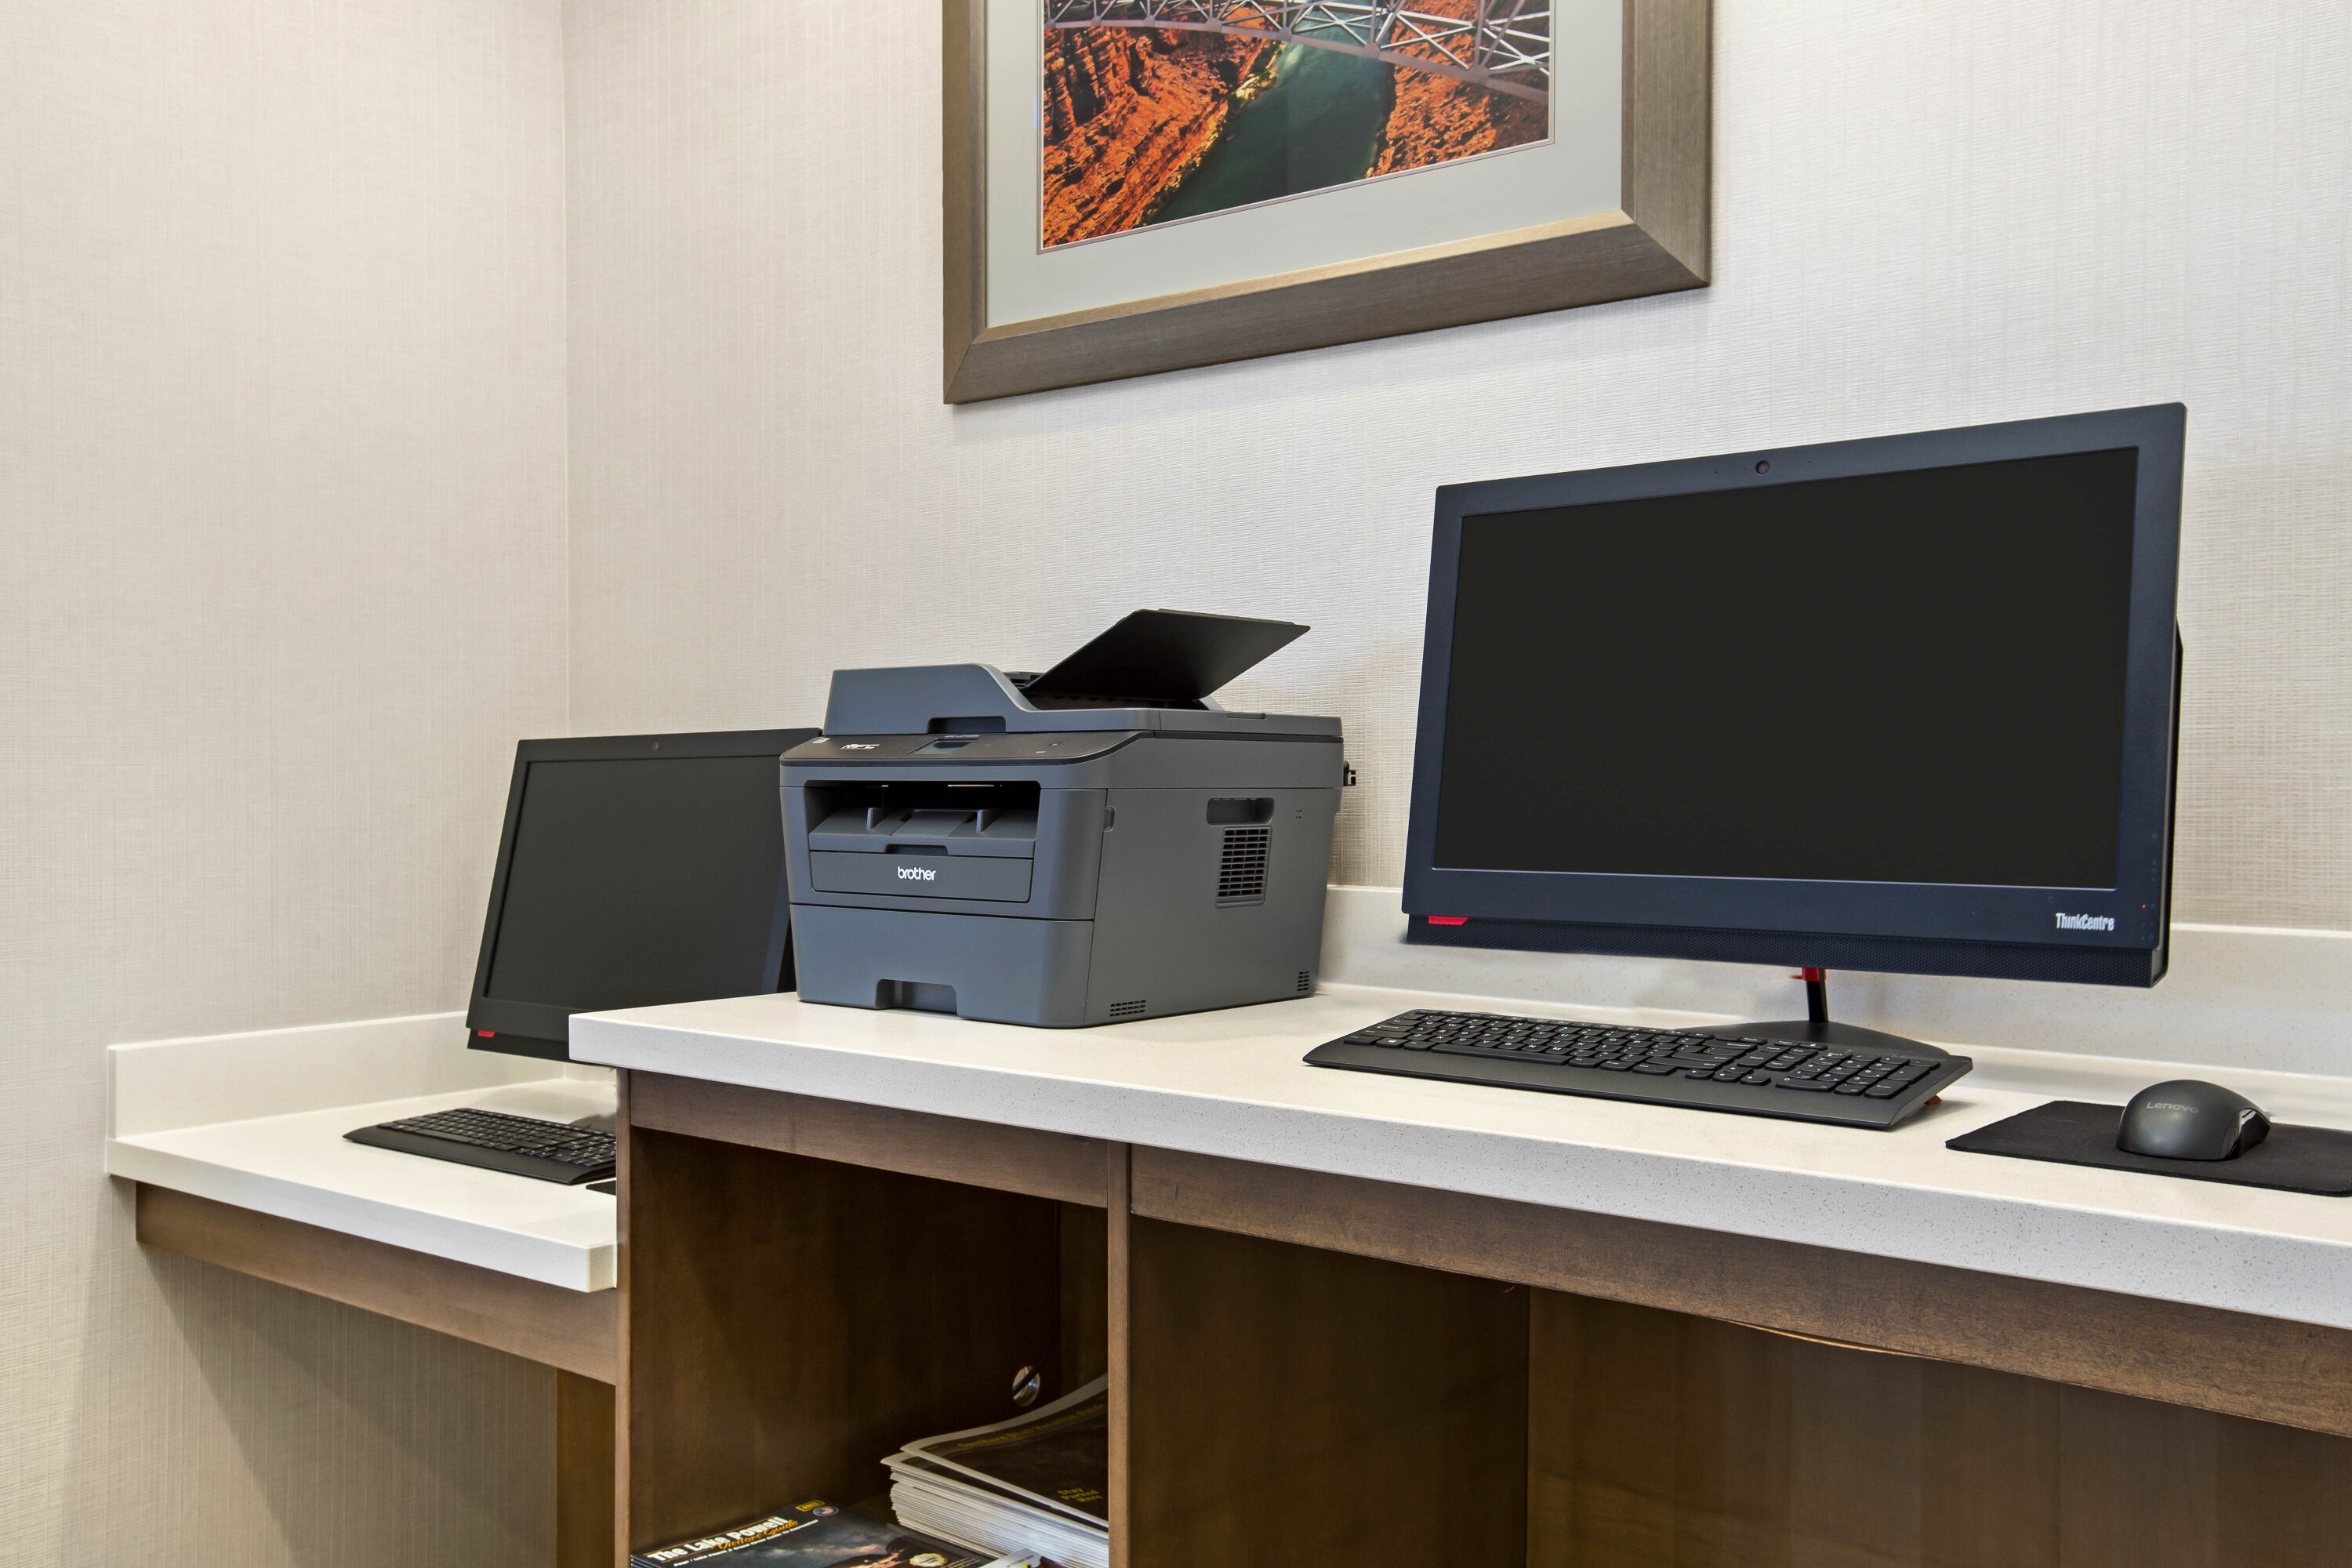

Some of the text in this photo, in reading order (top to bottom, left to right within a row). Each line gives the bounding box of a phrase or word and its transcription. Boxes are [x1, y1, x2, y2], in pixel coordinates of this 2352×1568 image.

[897, 866, 936, 881] brother
[2055, 912, 2115, 931] ThinkCentre
[2146, 1101, 2199, 1114] Lenovo
[646, 1548, 688, 1561] The
[683, 1537, 730, 1552] Lake
[726, 1516, 789, 1540] Powell
